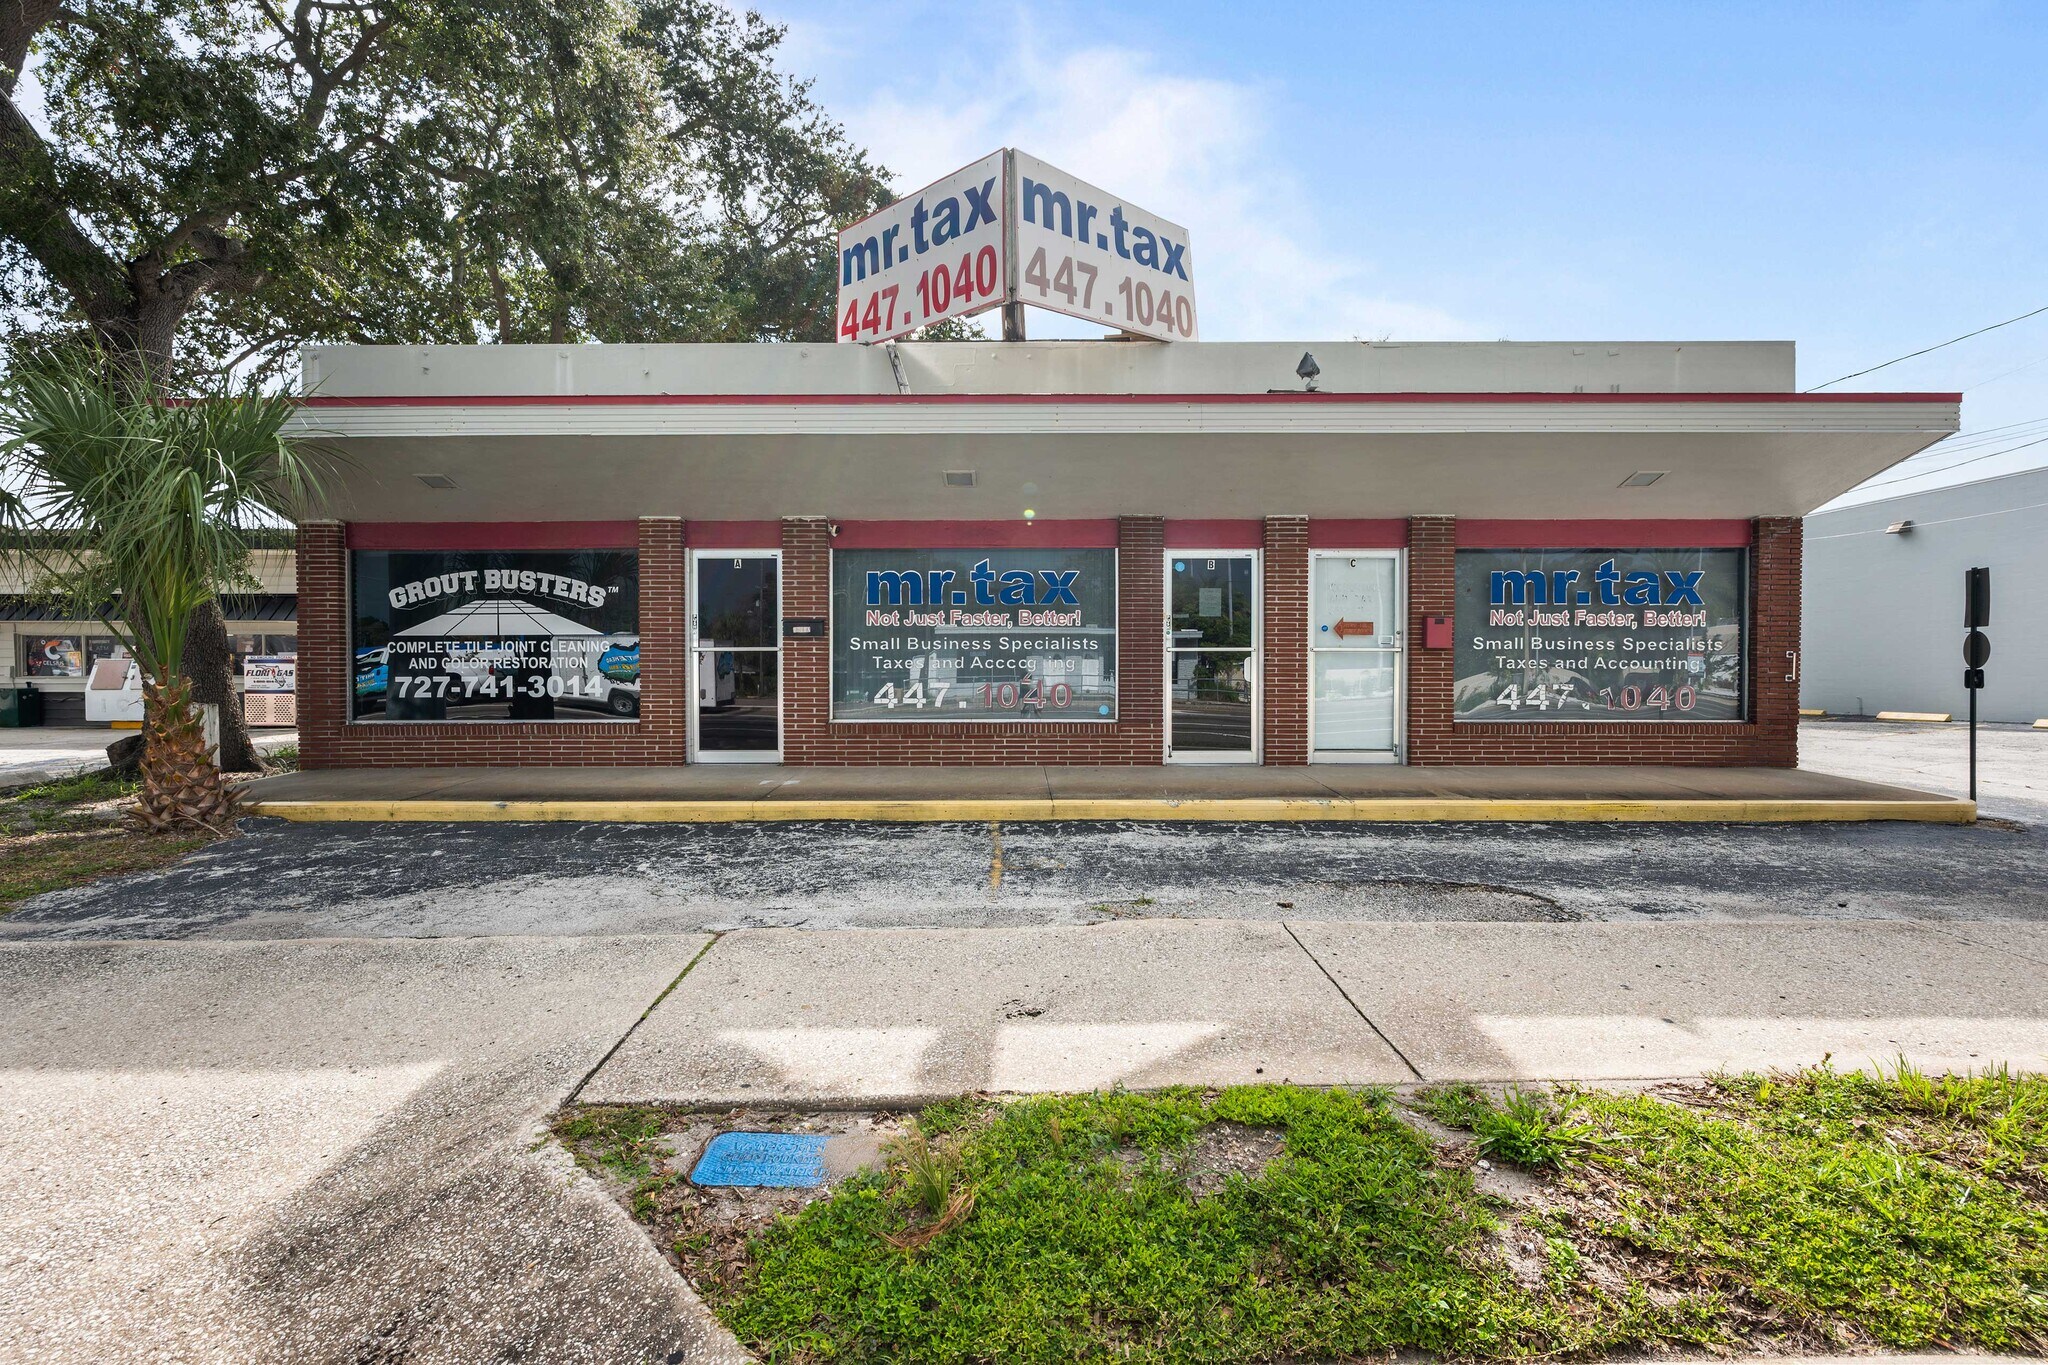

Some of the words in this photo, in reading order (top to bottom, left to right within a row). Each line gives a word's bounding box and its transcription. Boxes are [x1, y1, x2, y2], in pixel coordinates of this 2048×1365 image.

[842, 176, 998, 287] mr.tax
[1022, 177, 1188, 282] mr.tax
[841, 244, 998, 341] 447.1040
[1025, 246, 1193, 338] 447.1040
[734, 559, 741, 568] A
[1208, 561, 1214, 569] B
[1350, 558, 1356, 568] C
[388, 570, 480, 609] GROUT
[484, 569, 607, 609] BUSTERS
[866, 557, 1080, 606] mr.tax
[1490, 558, 1705, 606] mr.tax
[866, 610, 900, 627] Not
[904, 610, 945, 627] Just
[949, 610, 1013, 629] Faster,
[1018, 610, 1081, 627] Better!
[1490, 609, 1523, 627] Not
[1528, 609, 1570, 627] Just
[1574, 609, 1638, 629] Faster,
[1643, 609, 1707, 627] Better!
[387, 641, 462, 653] COMPLETE
[464, 641, 493, 652] TILE
[498, 641, 537, 652] JOINT
[540, 641, 610, 653] CLEANING
[849, 637, 900, 651] Small
[907, 637, 992, 651] Business
[998, 637, 1099, 653] Specialists
[1473, 637, 1524, 651] Small
[1531, 637, 1615, 651] Business
[1622, 637, 1723, 653] Specialists
[409, 657, 438, 669] AND
[441, 657, 489, 669] COLOR
[493, 657, 588, 669] RESTORATION
[872, 656, 925, 669] Taxes
[932, 656, 965, 669] and
[1495, 656, 1548, 670] Taxes
[1555, 656, 1588, 670] and
[1594, 655, 1701, 673] Accounting
[394, 675, 604, 699] 727-741-3014
